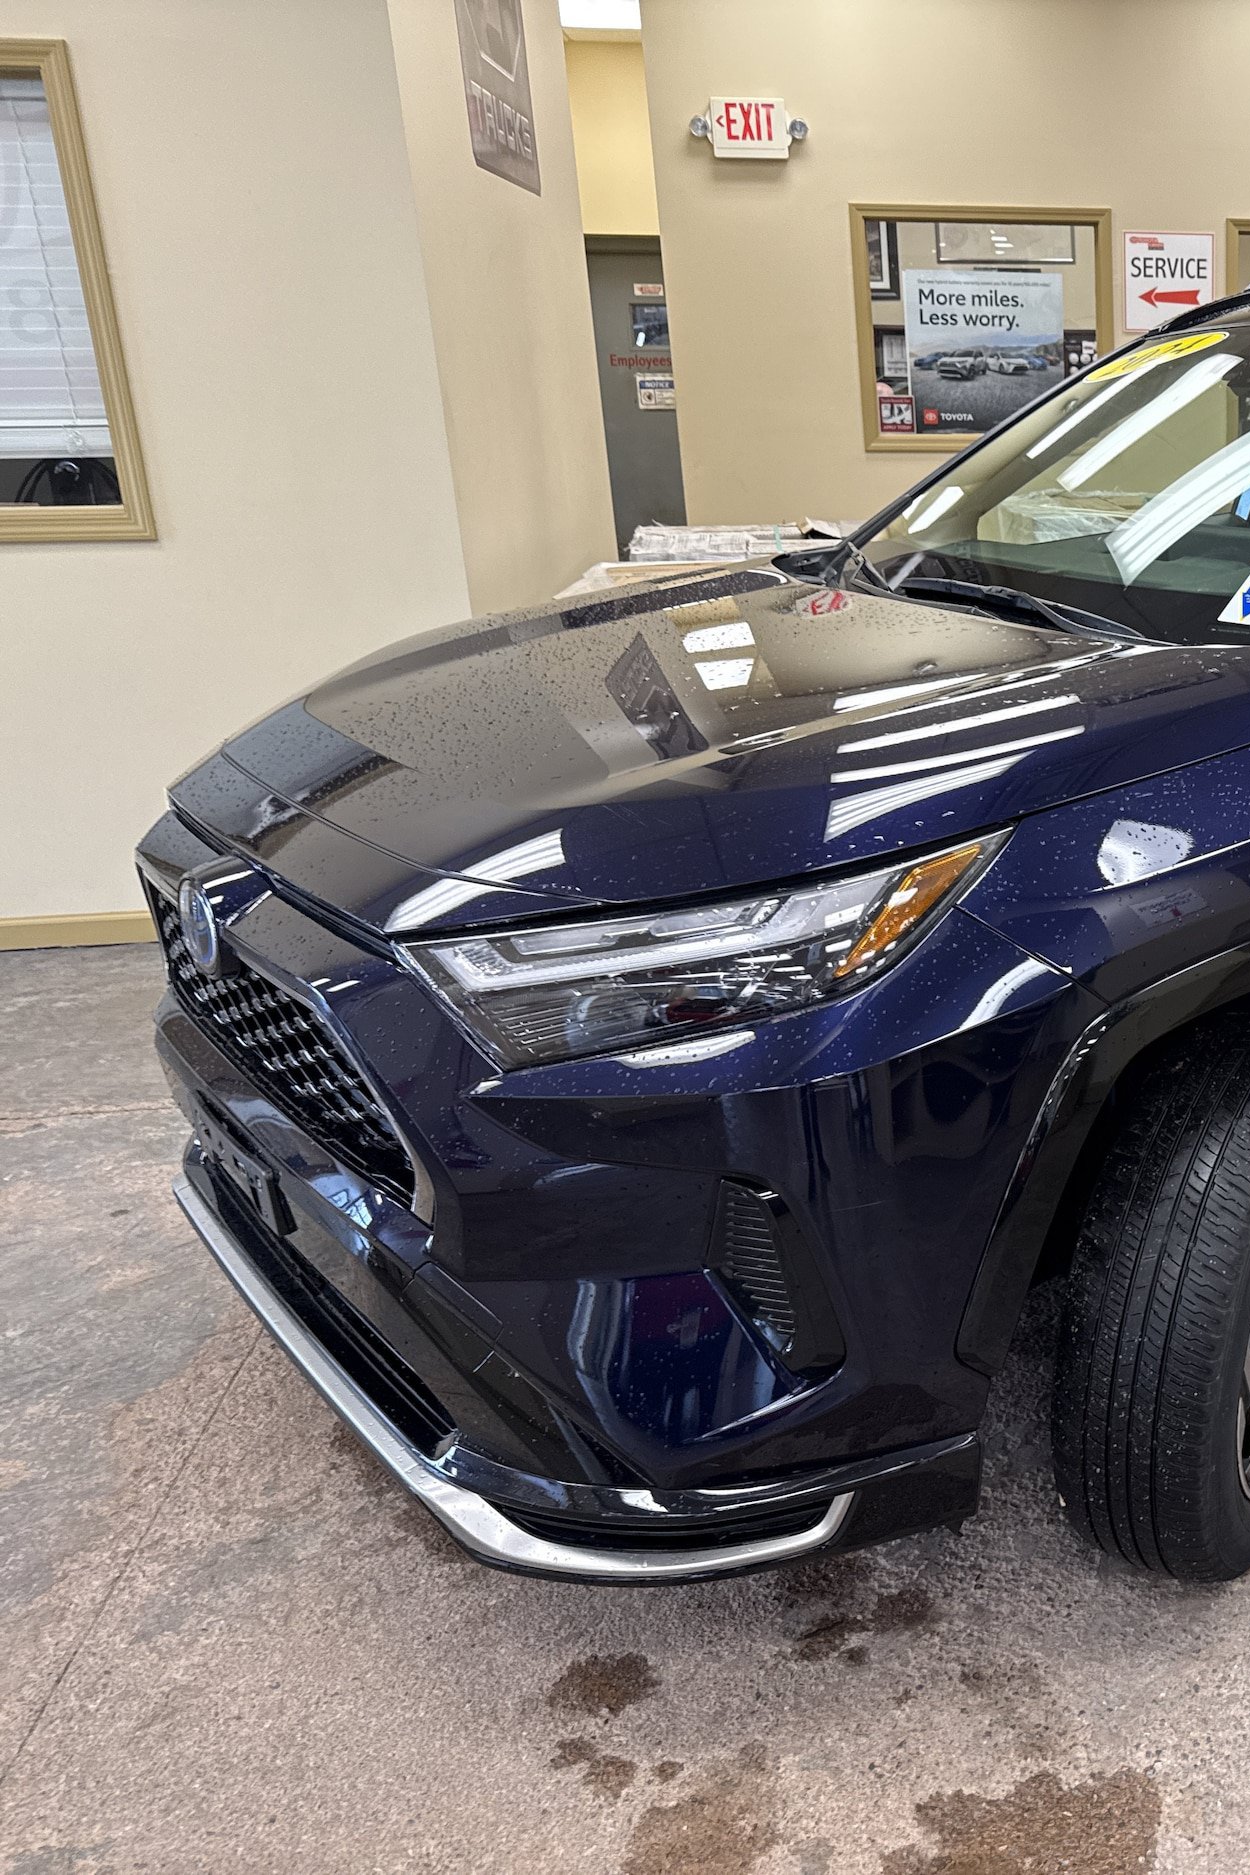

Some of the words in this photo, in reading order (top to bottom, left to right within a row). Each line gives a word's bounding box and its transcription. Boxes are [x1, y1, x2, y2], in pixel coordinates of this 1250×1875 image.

[470, 79, 533, 160] TRUCKS
[724, 102, 775, 141] EXIT
[1131, 257, 1207, 279] SERVICE
[918, 288, 966, 306] More
[971, 289, 1024, 308] miles.
[919, 308, 959, 326] Less
[963, 314, 1020, 331] worry.
[609, 354, 671, 369] Employees
[940, 413, 974, 421] TOYOTA
